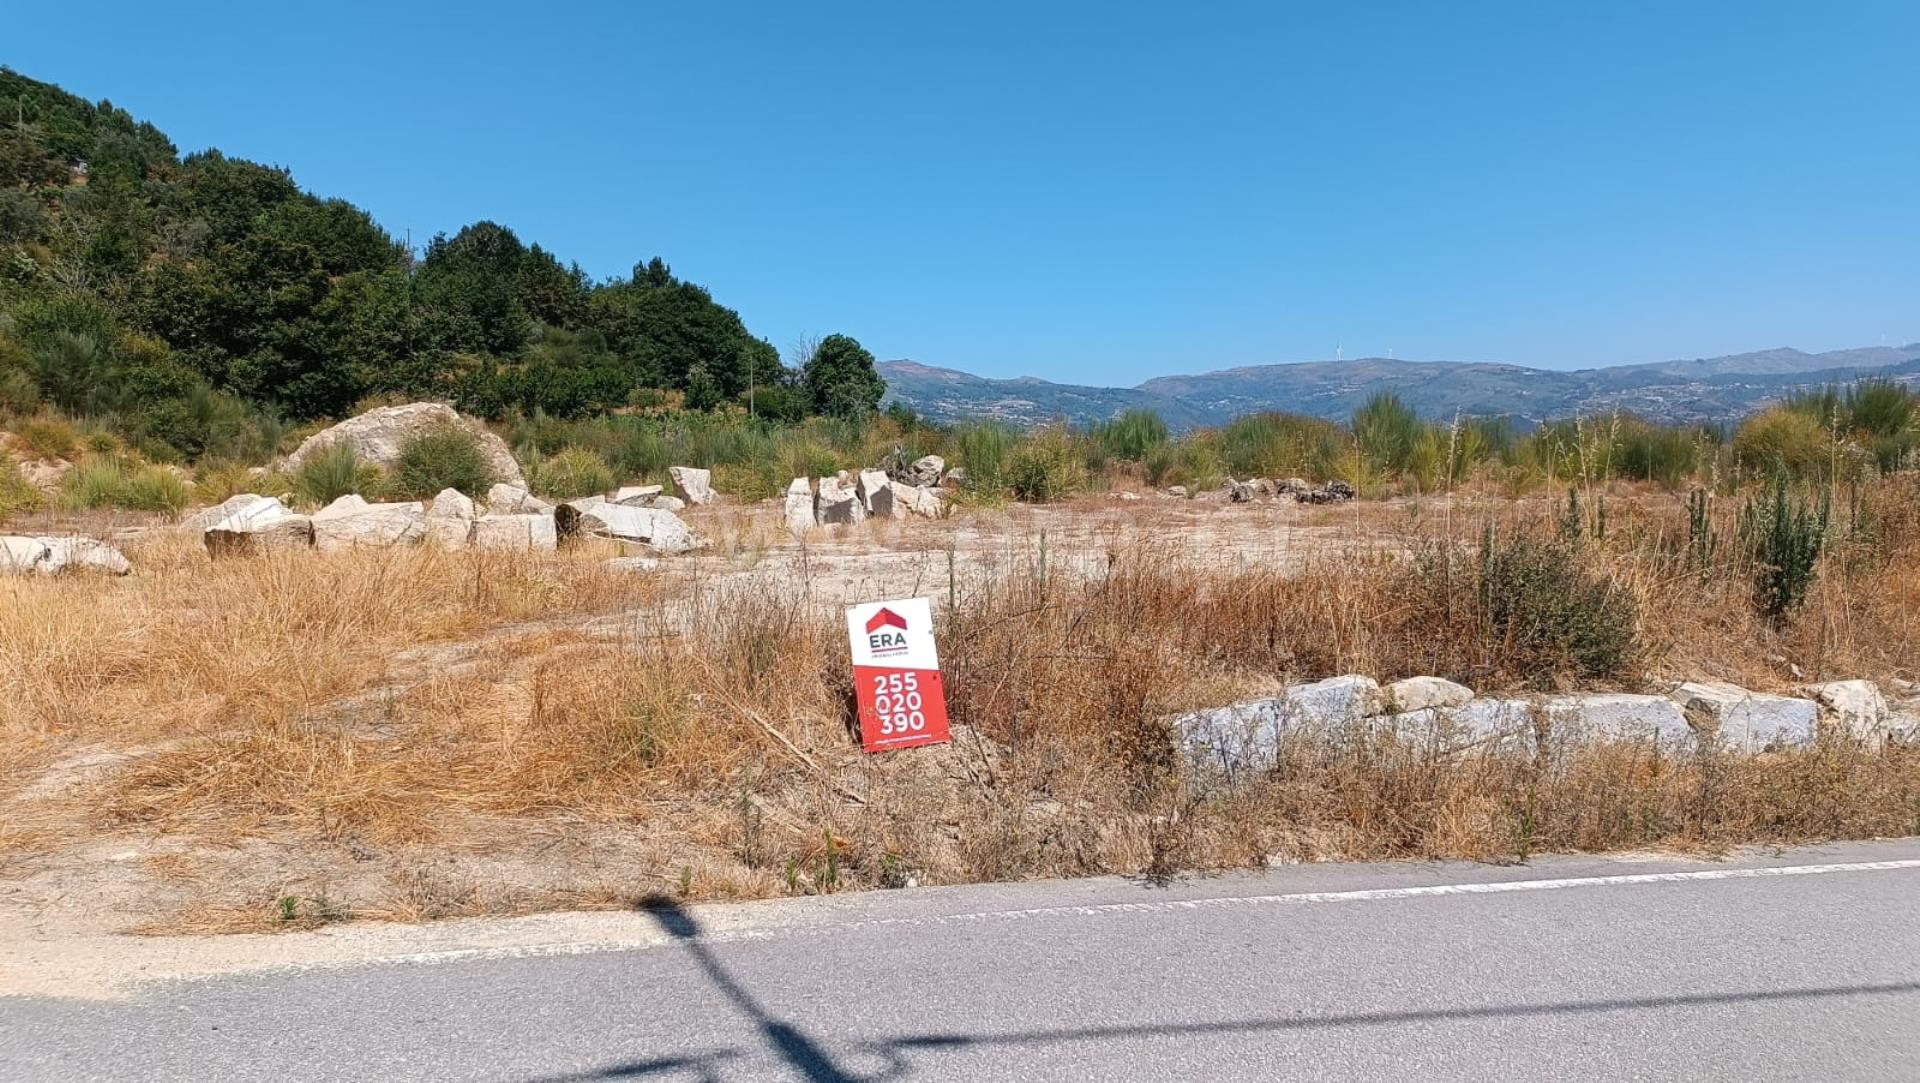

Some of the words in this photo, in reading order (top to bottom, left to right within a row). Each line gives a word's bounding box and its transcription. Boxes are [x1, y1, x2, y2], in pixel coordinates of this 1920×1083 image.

[870, 632, 907, 648] ERA
[874, 672, 918, 695] 255
[876, 692, 922, 714] 020
[880, 711, 925, 735] 390
